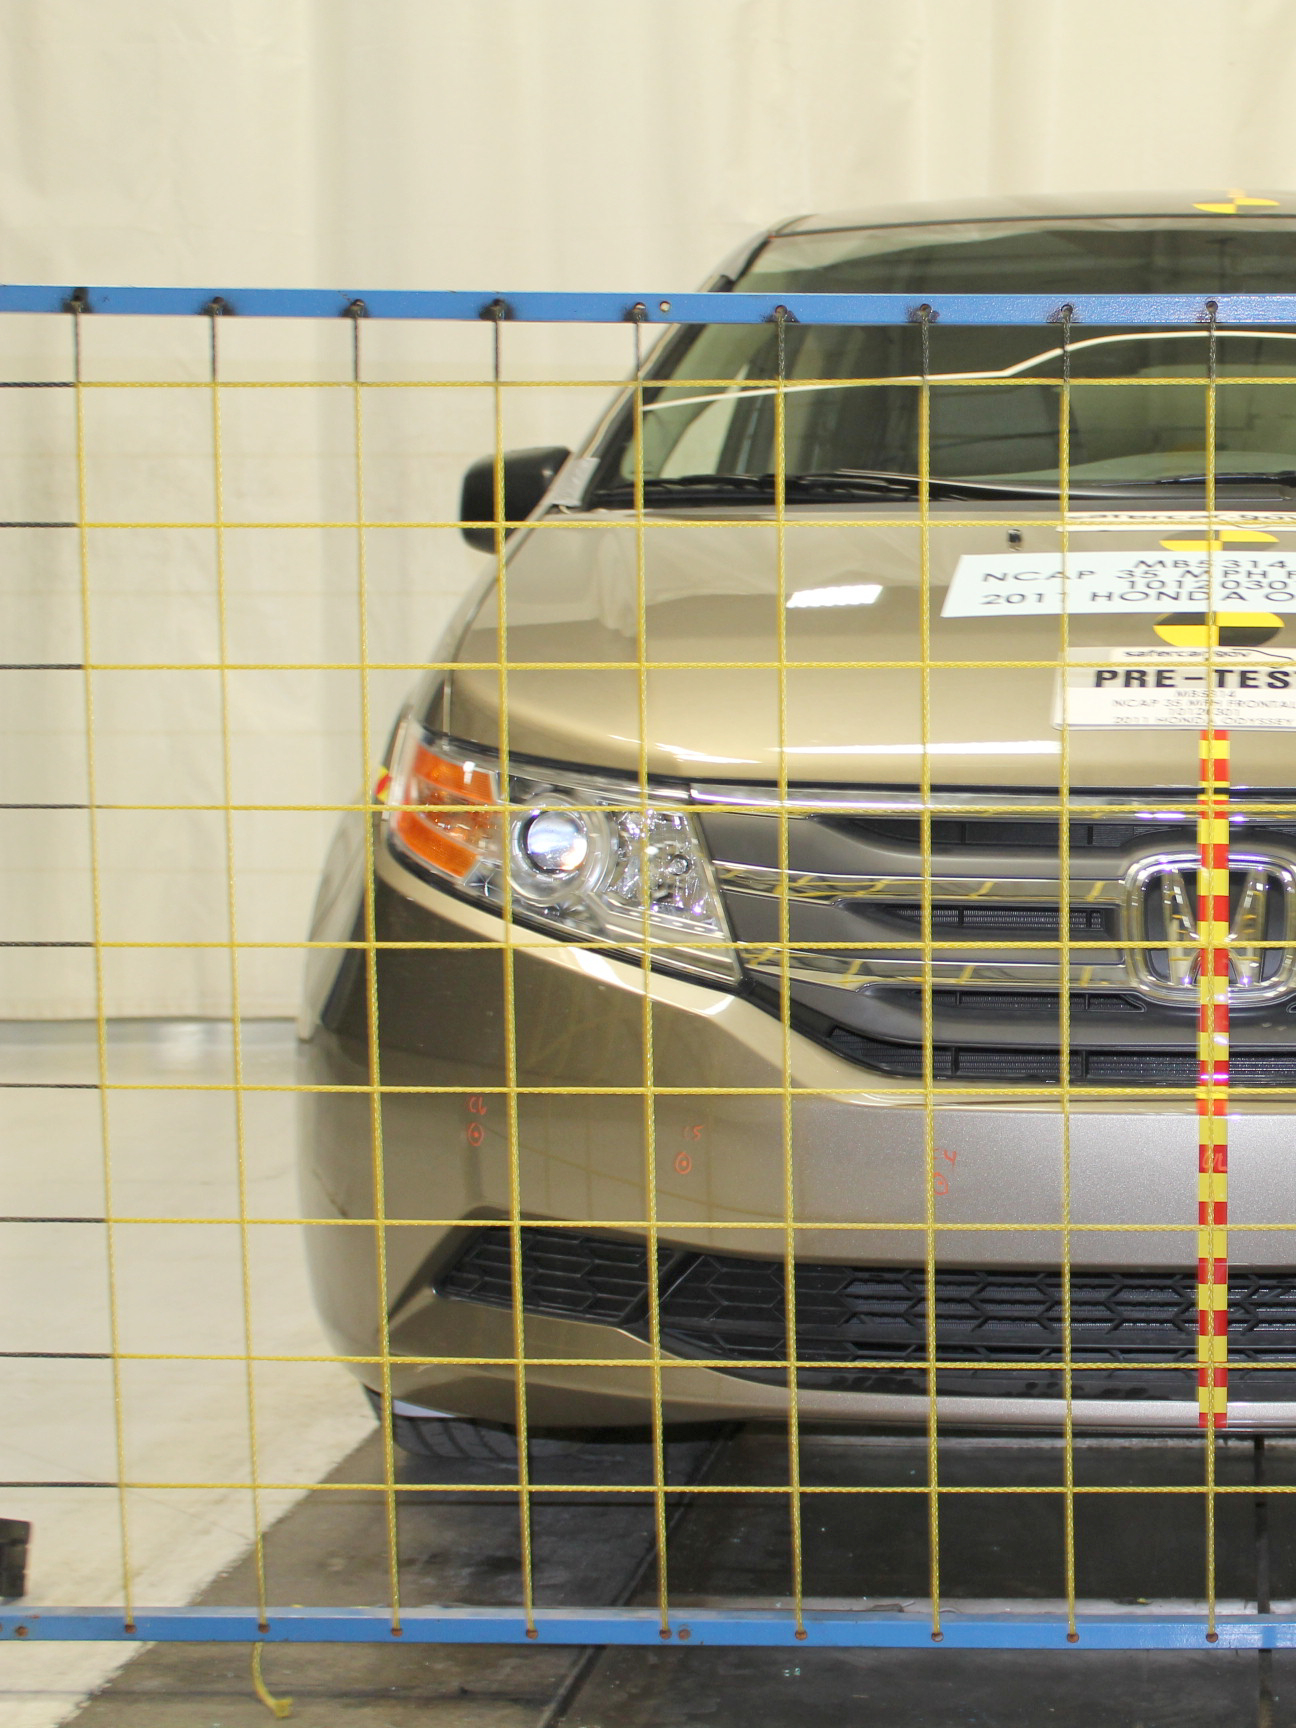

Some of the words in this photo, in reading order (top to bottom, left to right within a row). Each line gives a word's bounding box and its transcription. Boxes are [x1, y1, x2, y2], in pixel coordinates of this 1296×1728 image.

[1134, 559, 1288, 569] MB5314
[981, 570, 1096, 583] NCAP
[1114, 569, 1160, 580] 35
[1180, 569, 1269, 580] MPH
[1090, 591, 1248, 602] HONDA
